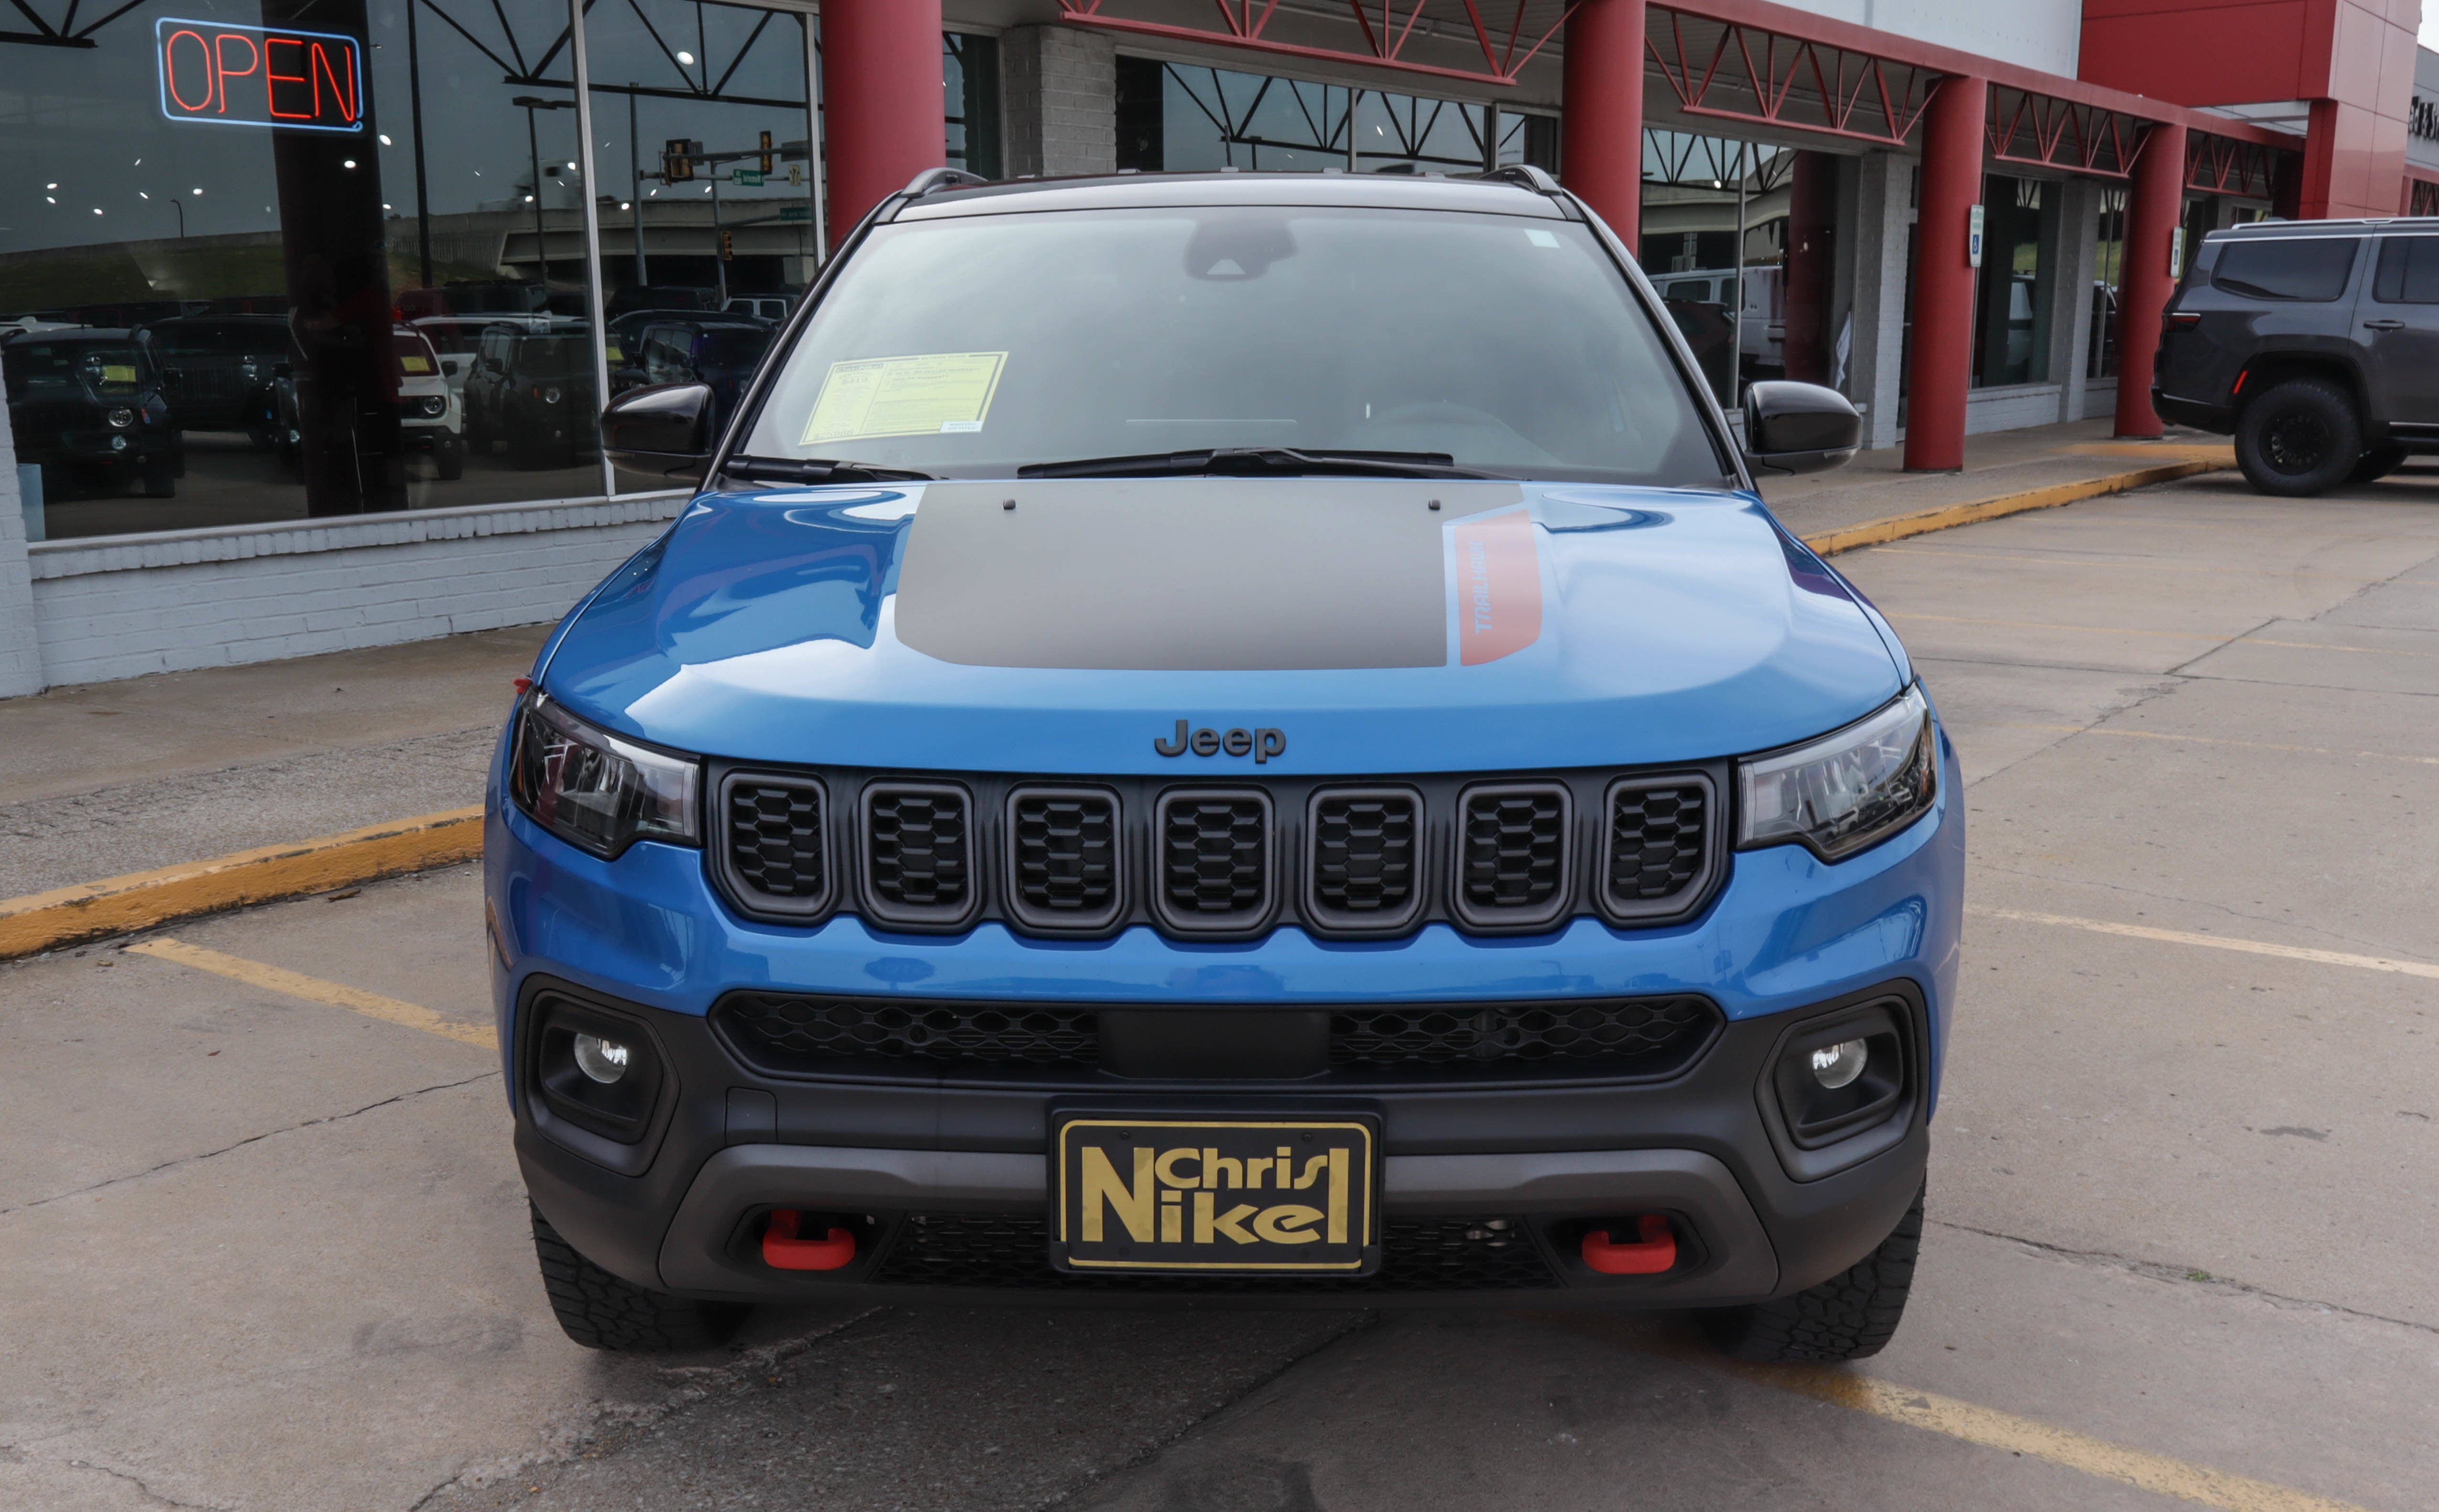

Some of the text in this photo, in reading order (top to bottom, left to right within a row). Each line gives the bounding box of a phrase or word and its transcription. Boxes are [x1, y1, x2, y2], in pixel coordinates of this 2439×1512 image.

[167, 30, 355, 122] OPEN
[1468, 540, 1493, 634] TRAILHAWK
[1154, 719, 1286, 764] Jeep
[1082, 1146, 1349, 1245] Nikel
[1155, 1146, 1328, 1189] Chris
